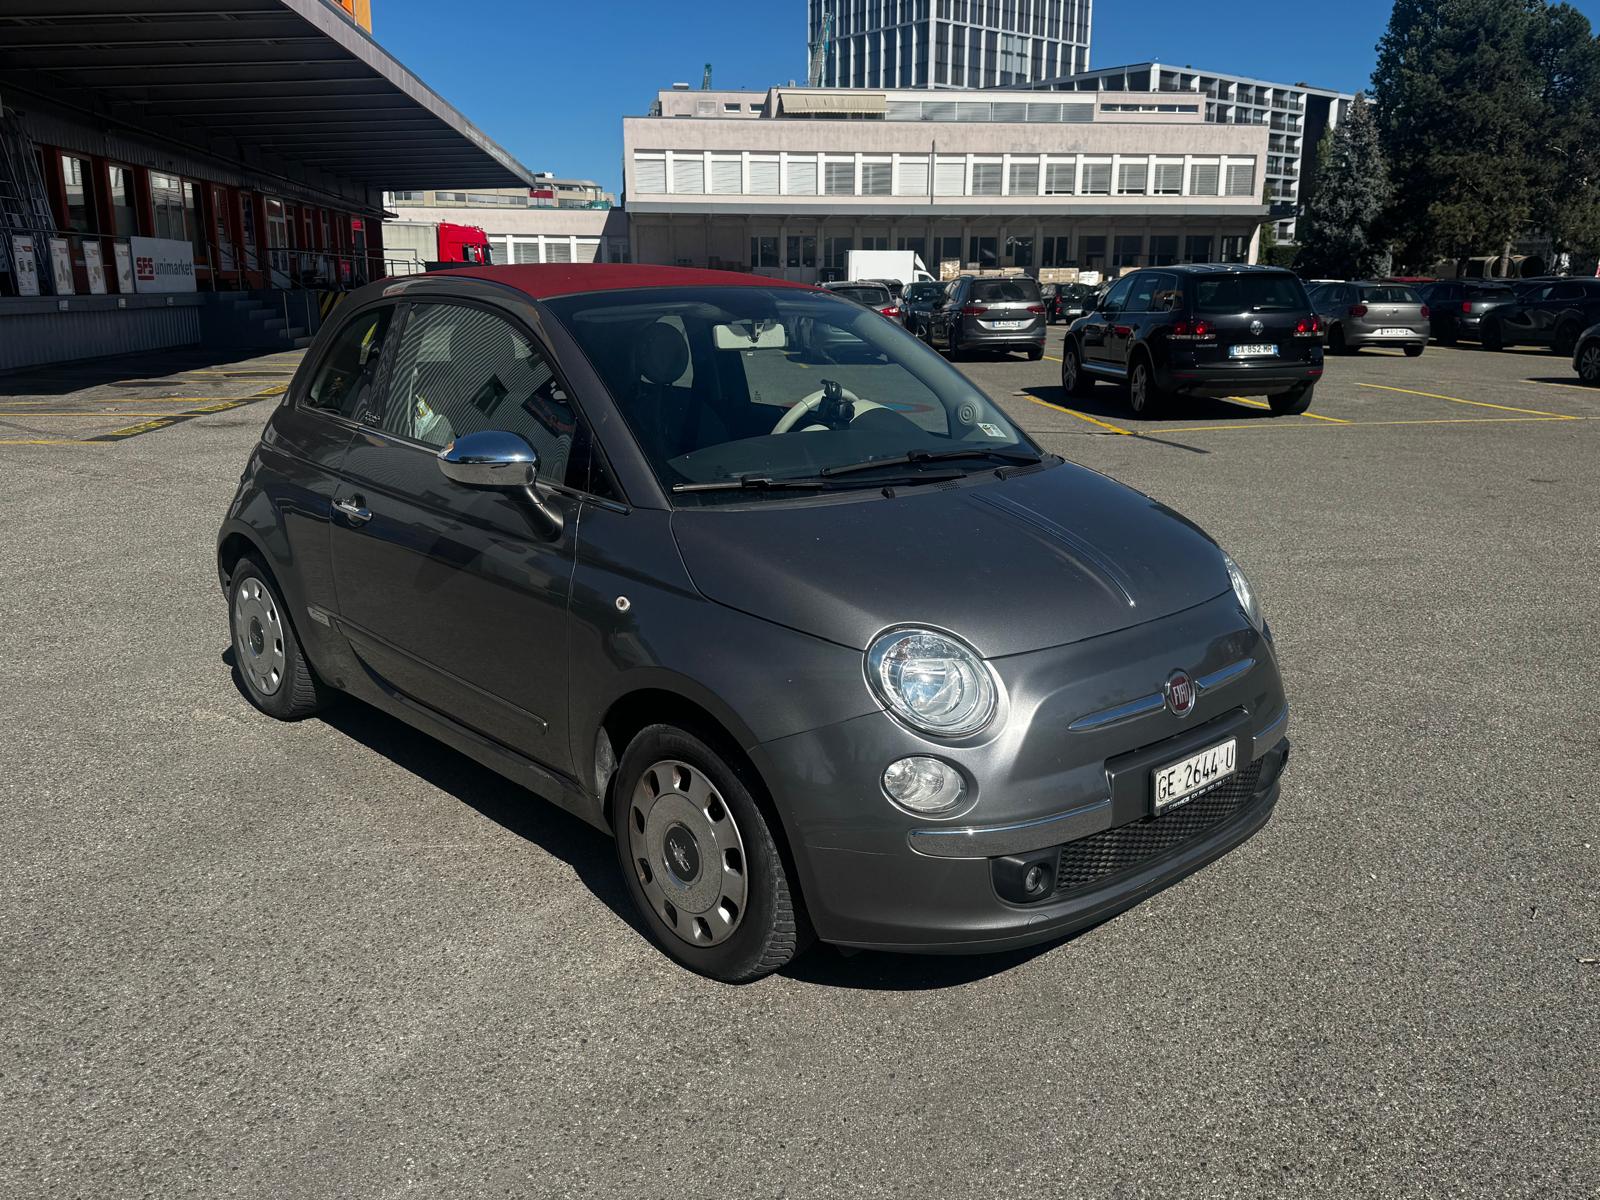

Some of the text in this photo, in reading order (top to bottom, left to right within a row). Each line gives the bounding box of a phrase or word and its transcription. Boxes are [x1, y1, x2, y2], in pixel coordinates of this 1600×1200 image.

[136, 256, 193, 276] SFS unimarket
[1172, 681, 1190, 706] FIAT
